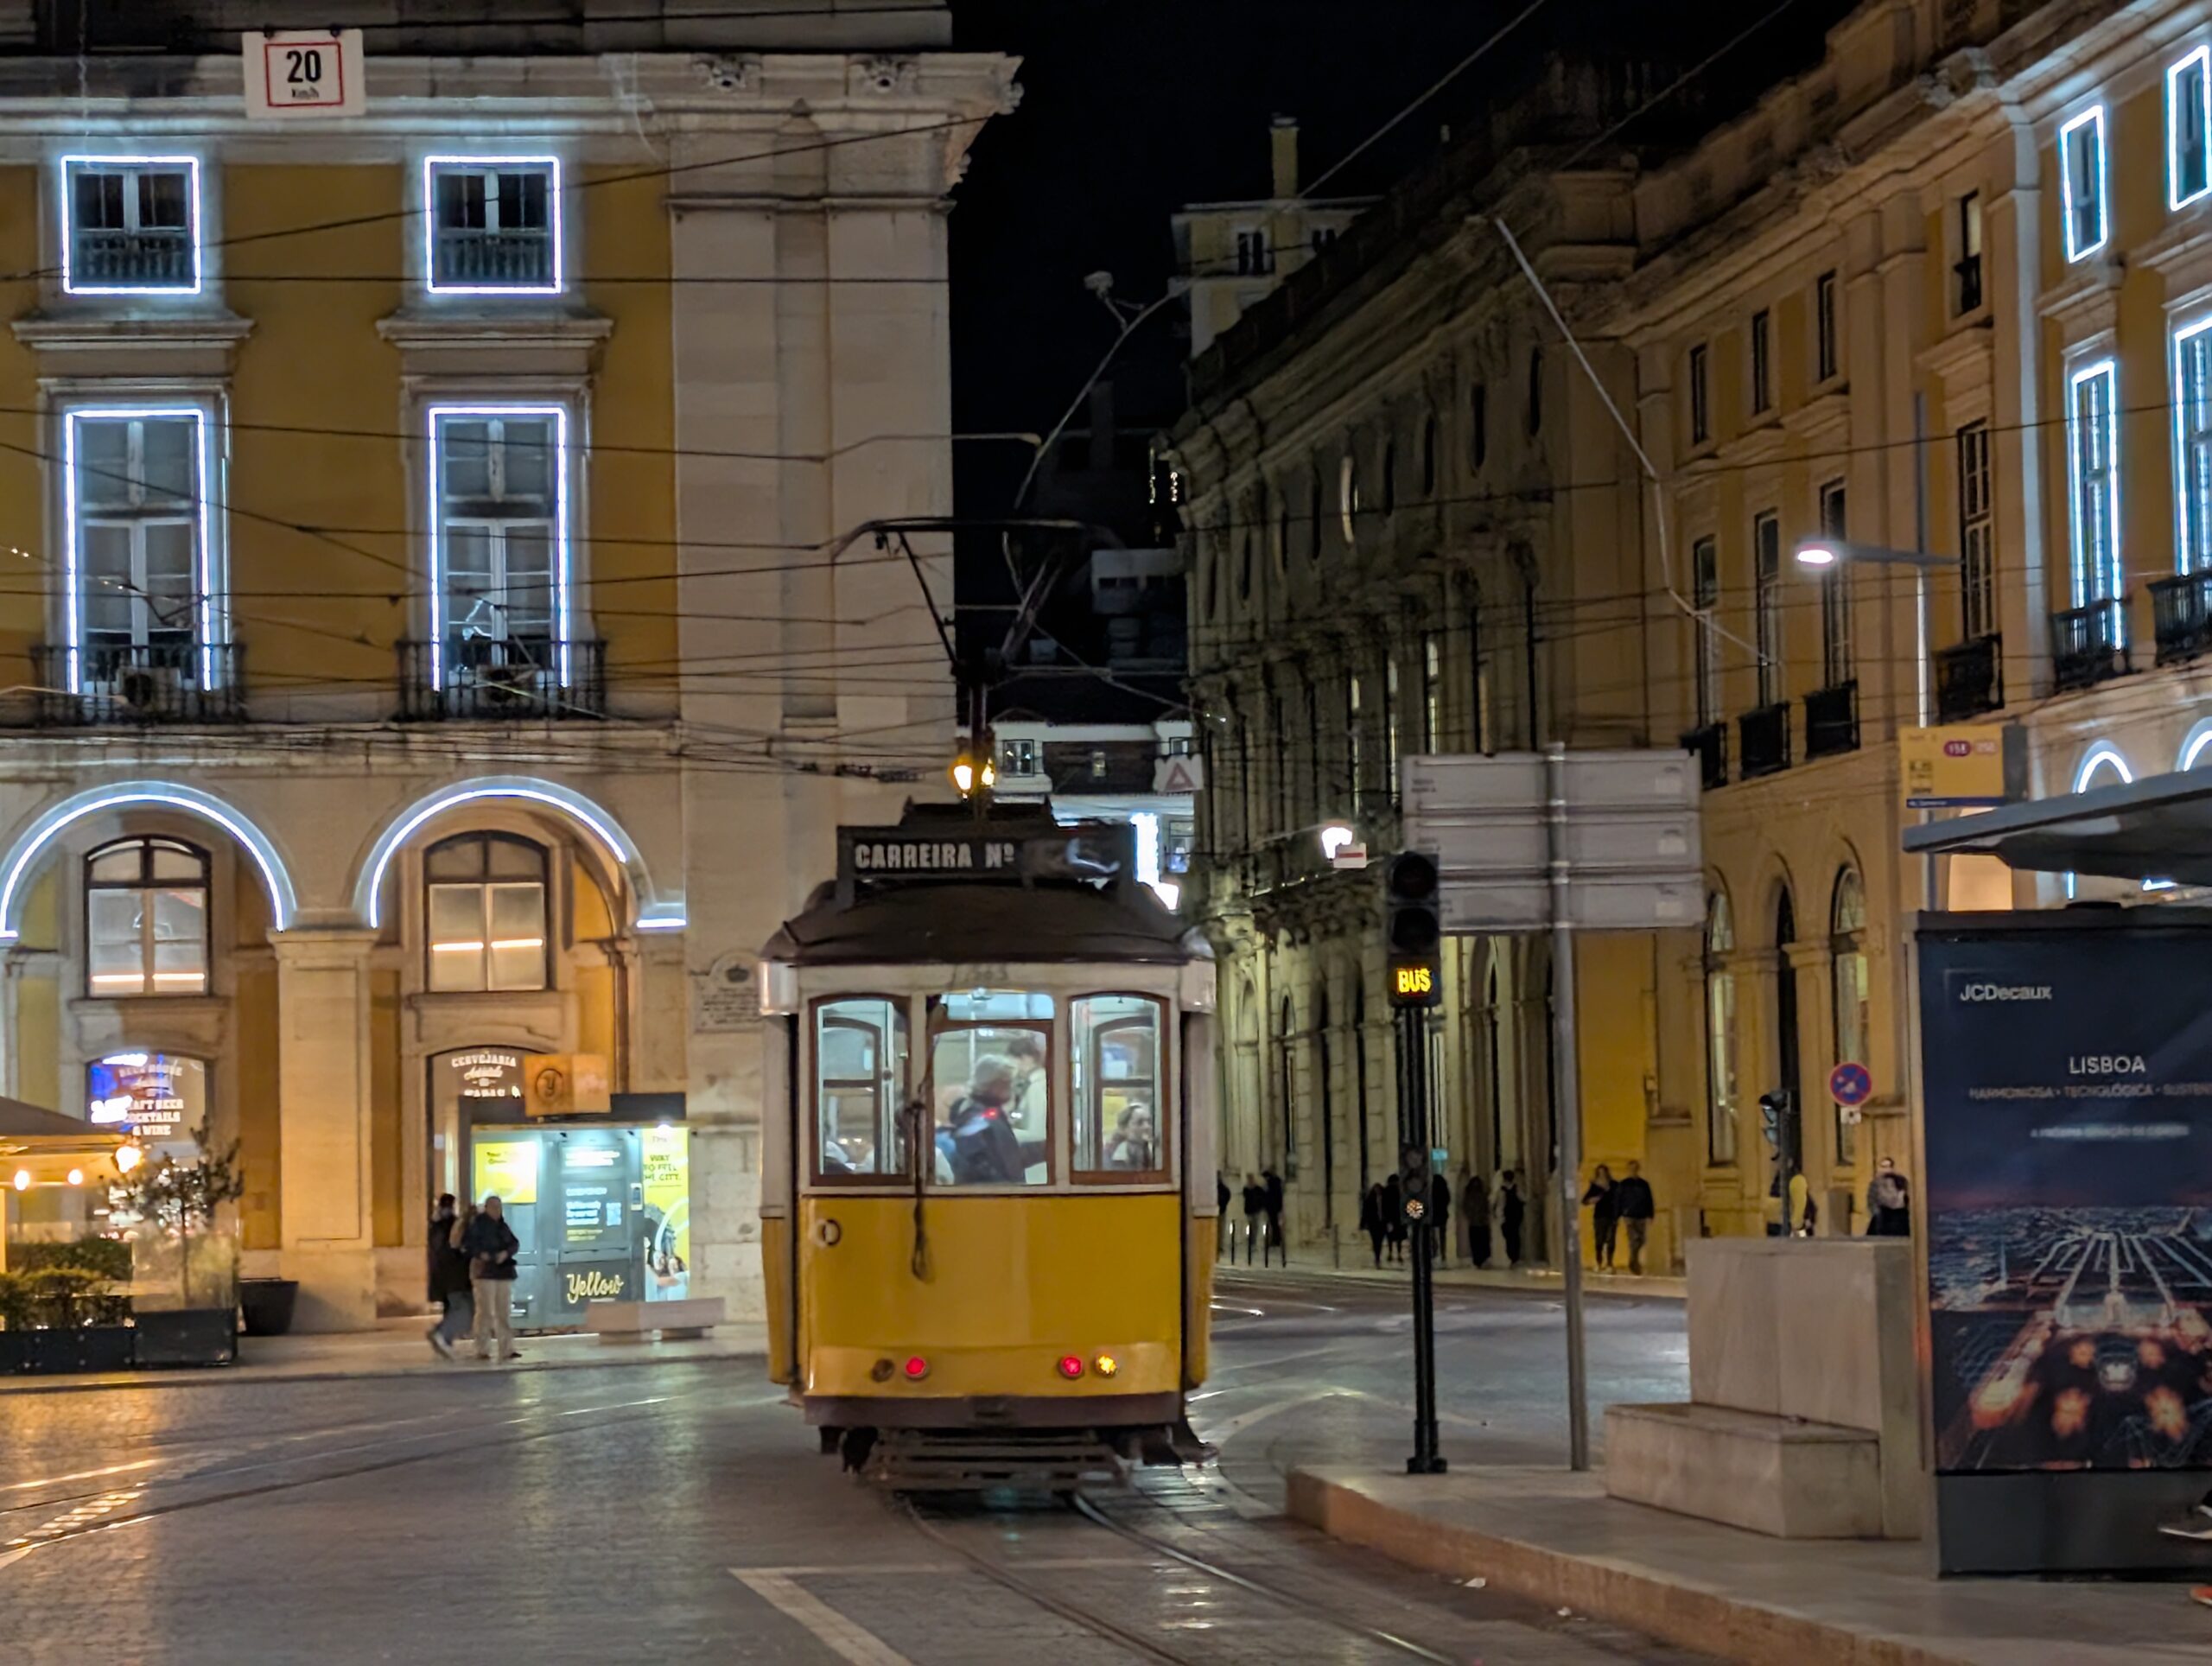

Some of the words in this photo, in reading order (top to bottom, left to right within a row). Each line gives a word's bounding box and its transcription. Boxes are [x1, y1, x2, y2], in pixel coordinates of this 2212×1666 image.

[286, 50, 321, 83] 20
[855, 843, 973, 869] CARREIRA
[1397, 968, 1432, 993] BUS
[1960, 984, 2053, 1002] JCDecaux
[451, 1052, 517, 1068] CERVEJARIA
[2069, 1055, 2146, 1074] LISBOA
[566, 1271, 624, 1304] Yellow
